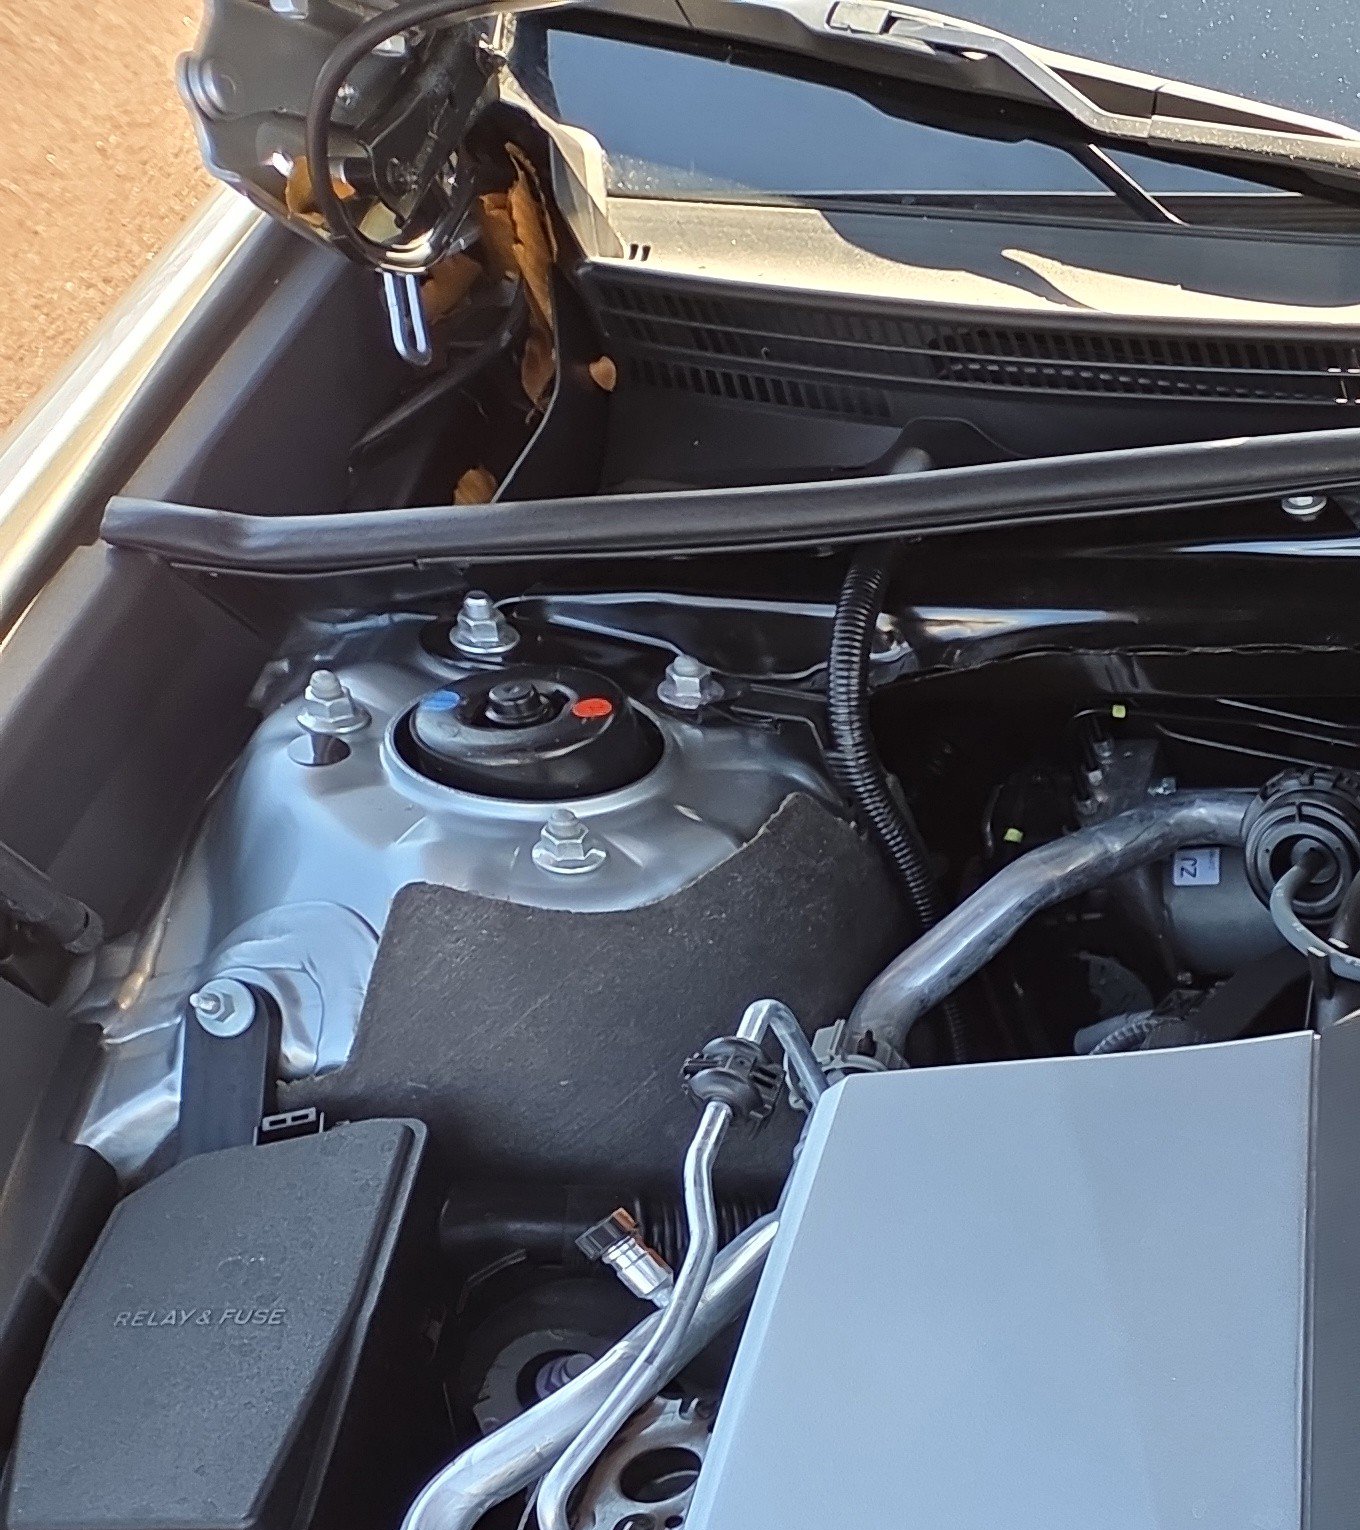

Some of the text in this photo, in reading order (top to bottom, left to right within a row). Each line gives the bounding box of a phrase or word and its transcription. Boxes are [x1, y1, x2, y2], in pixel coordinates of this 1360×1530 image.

[113, 1308, 287, 1327] RELAY & FUSE
